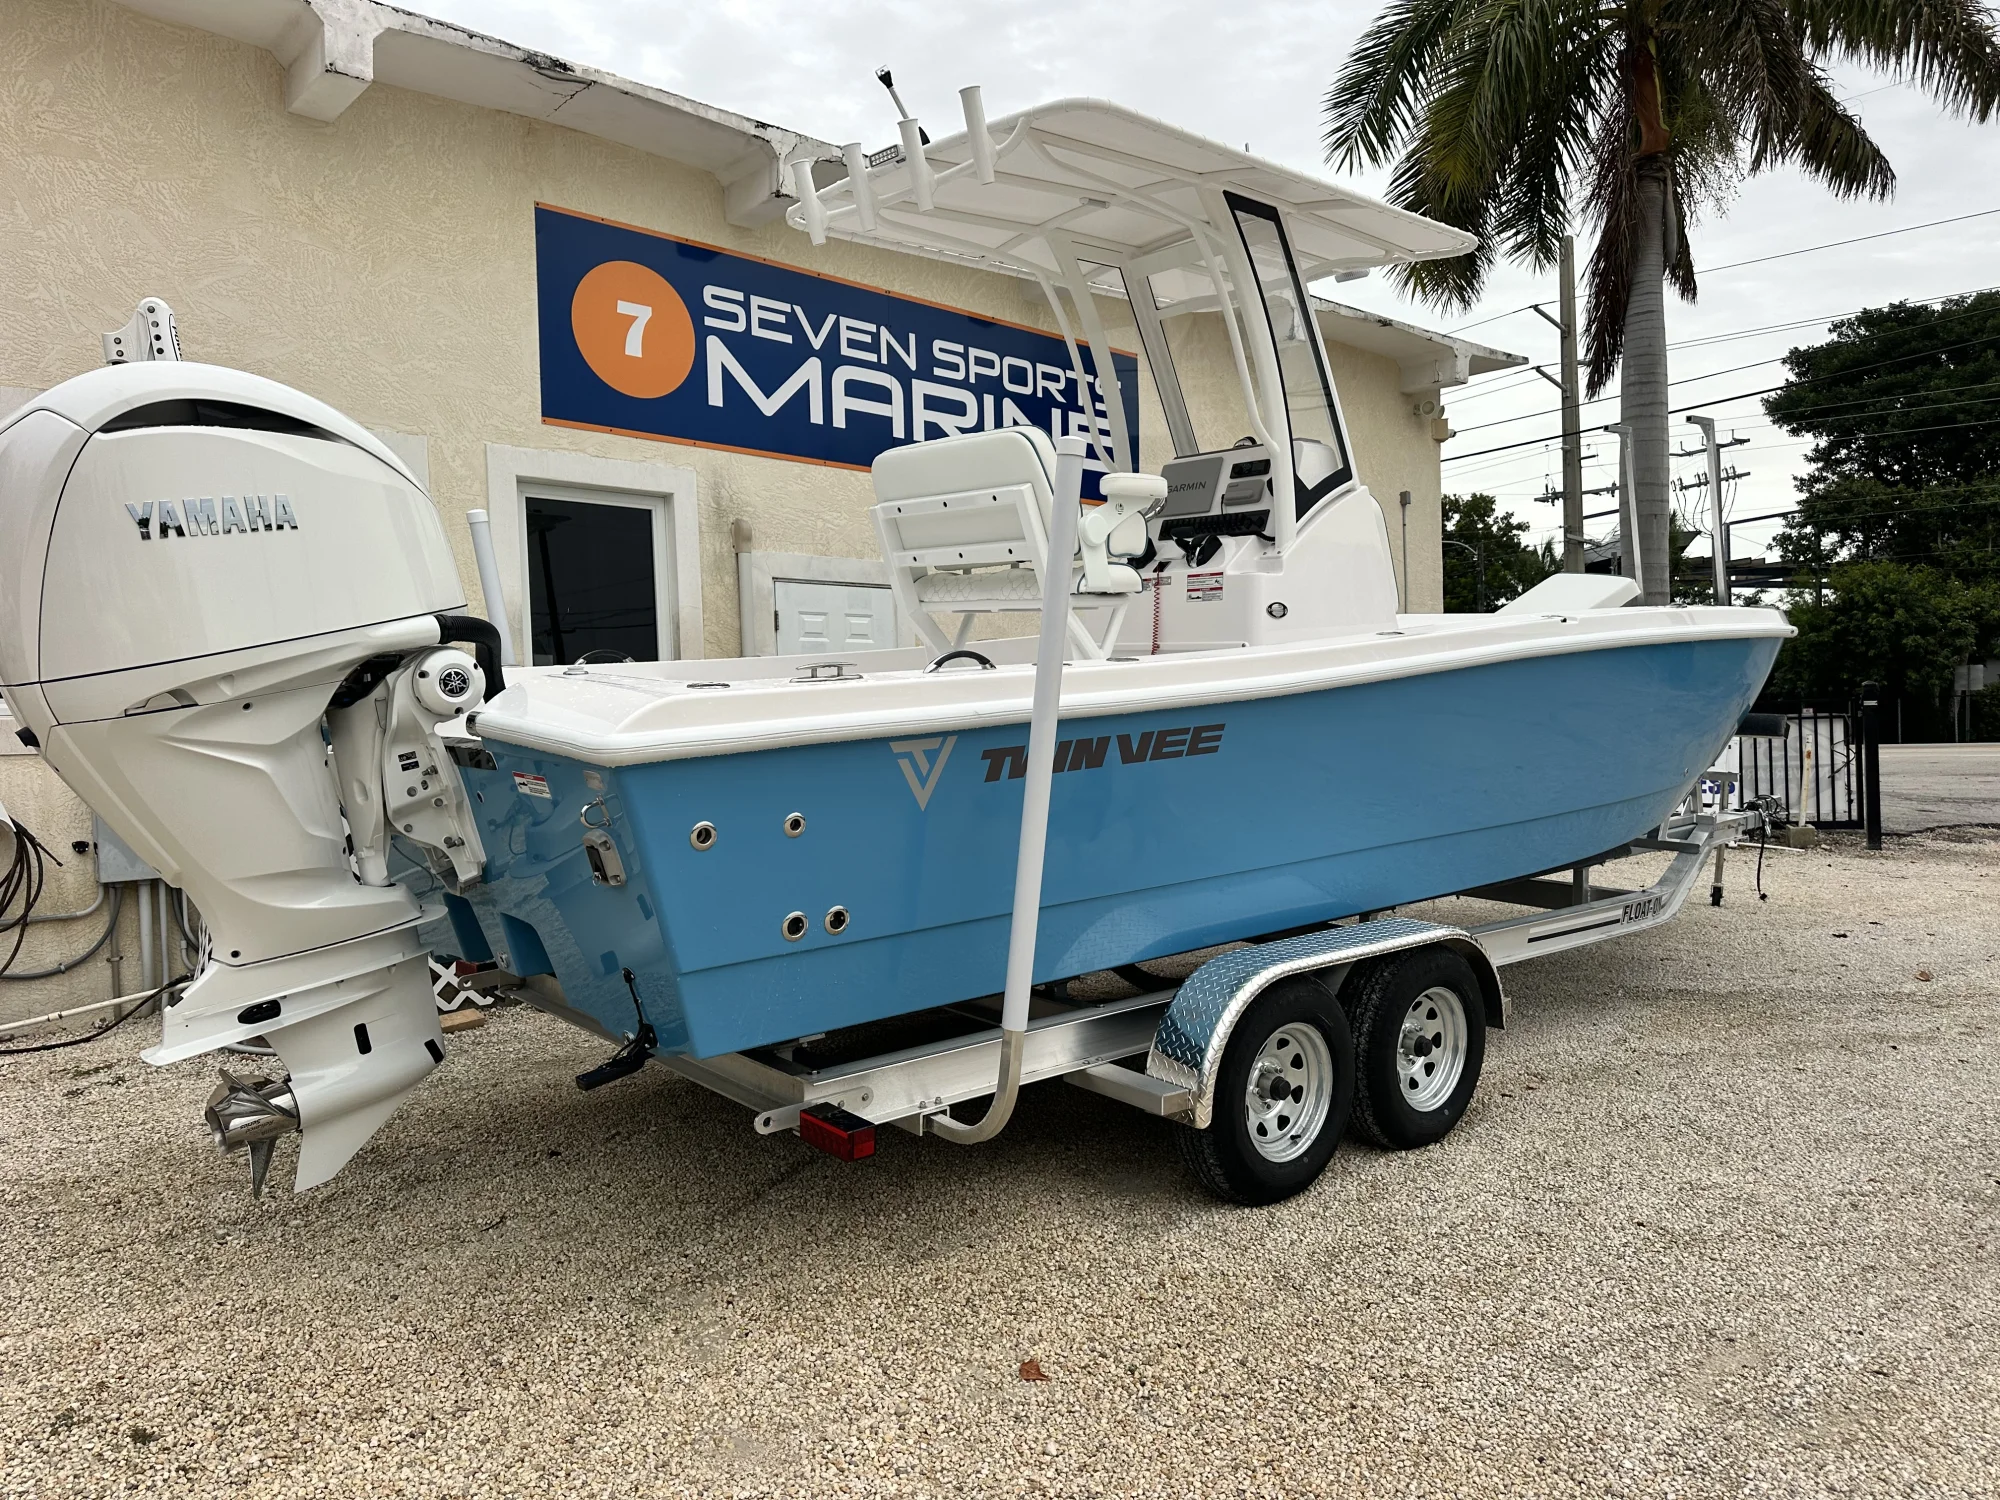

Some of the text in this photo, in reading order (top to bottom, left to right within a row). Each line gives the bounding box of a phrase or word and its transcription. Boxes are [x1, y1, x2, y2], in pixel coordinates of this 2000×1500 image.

[616, 299, 653, 358] 7
[702, 284, 917, 372] SEVEN
[125, 494, 298, 541] YAMAHA
[1116, 723, 1226, 765] VEE
